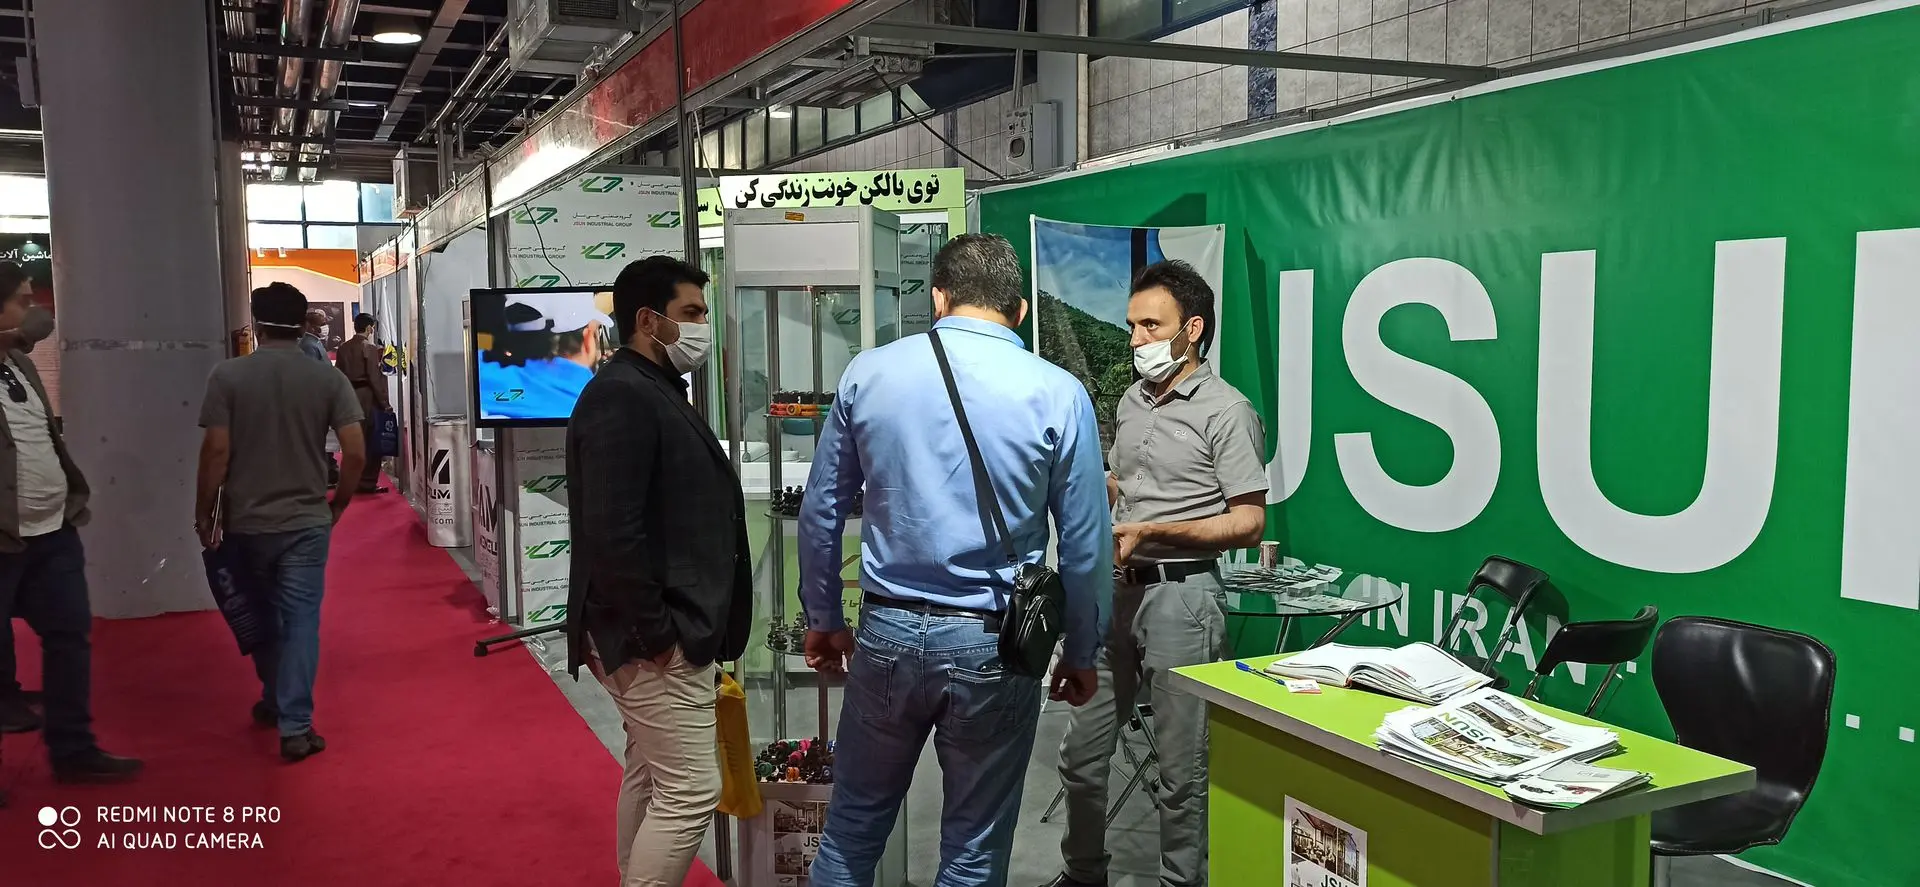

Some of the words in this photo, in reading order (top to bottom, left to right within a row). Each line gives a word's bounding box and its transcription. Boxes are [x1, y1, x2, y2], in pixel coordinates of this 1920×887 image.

[735, 178, 760, 209] کن
[761, 177, 810, 208] زندگی
[811, 175, 858, 207] خونت
[859, 172, 905, 205] بالکن
[906, 174, 940, 204] توی
[1438, 711, 1496, 743] JSUN
